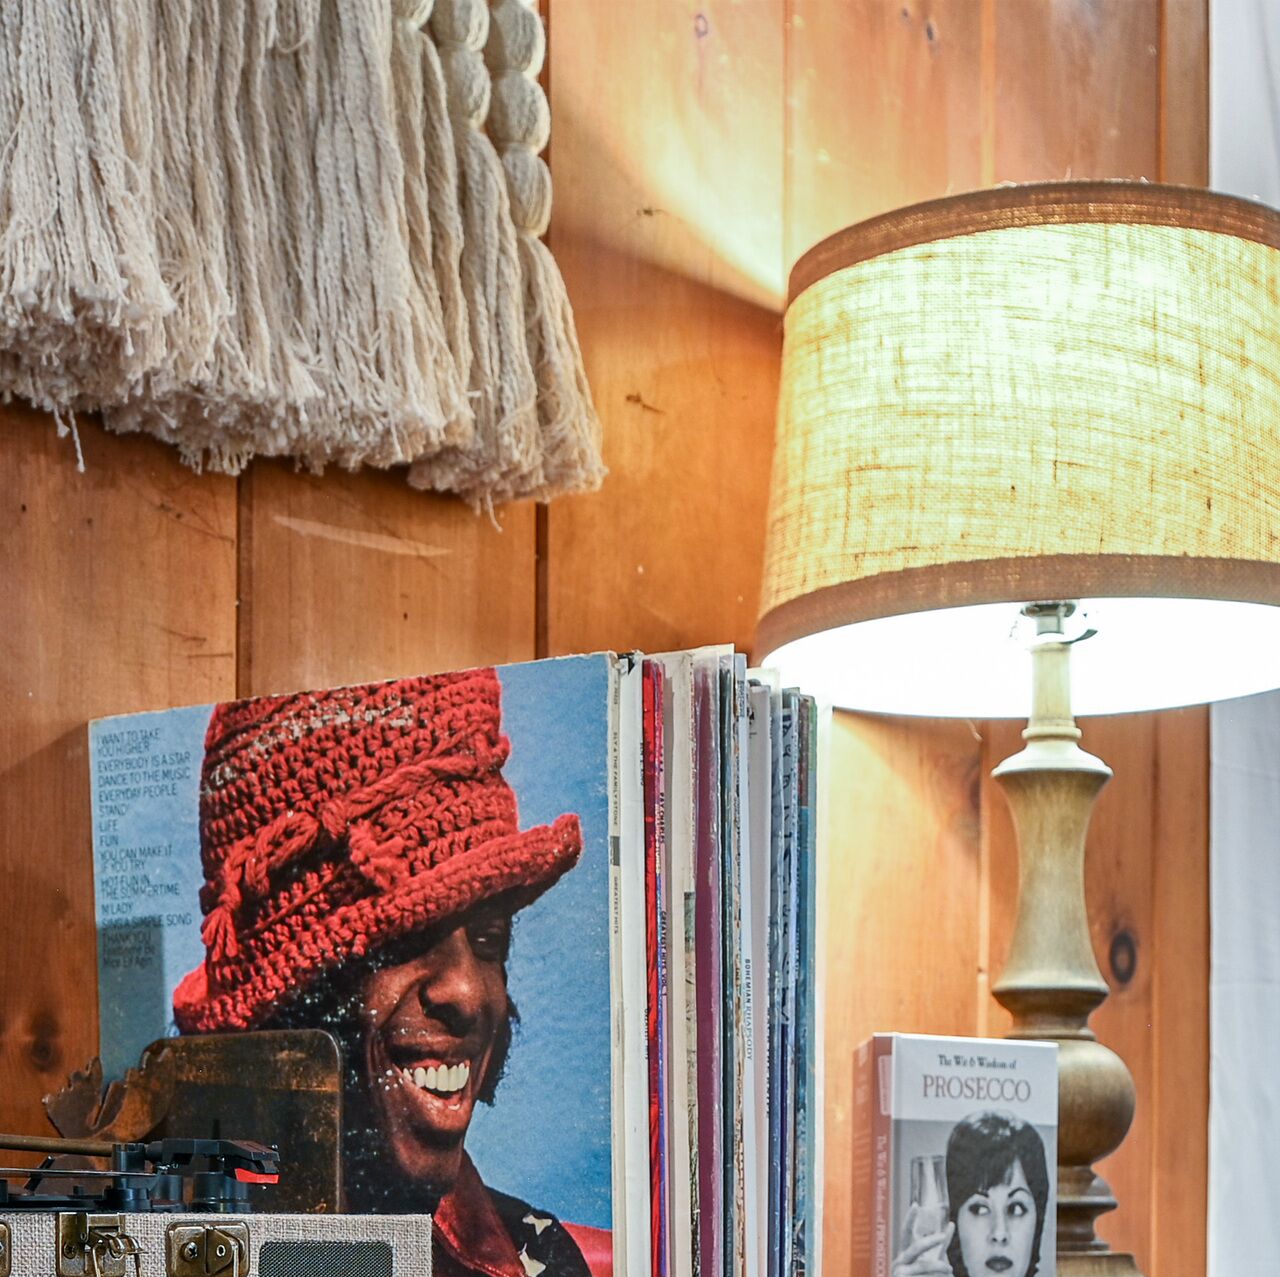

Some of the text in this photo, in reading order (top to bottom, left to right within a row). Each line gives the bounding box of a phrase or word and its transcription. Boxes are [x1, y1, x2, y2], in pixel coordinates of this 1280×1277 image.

[126, 729, 139, 742] TO
[140, 727, 161, 741] TAKE
[98, 757, 148, 773] EVERYBODY
[151, 754, 160, 768] IS
[168, 751, 191, 765] STAR
[98, 766, 191, 788] DANCE TO THE MUSIC
[143, 782, 177, 798] PEOPLE
[99, 819, 118, 832] LIFE
[100, 835, 119, 847] FUN
[100, 849, 117, 861] YOU
[119, 847, 136, 860] CAN
[139, 845, 161, 858] MAKE
[110, 860, 128, 873] YOU
[130, 858, 146, 871] TRY
[166, 912, 192, 926] SONG
[938, 1054, 952, 1067] The
[1009, 1060, 1017, 1070] of
[922, 1073, 1031, 1103] PROSECCO
